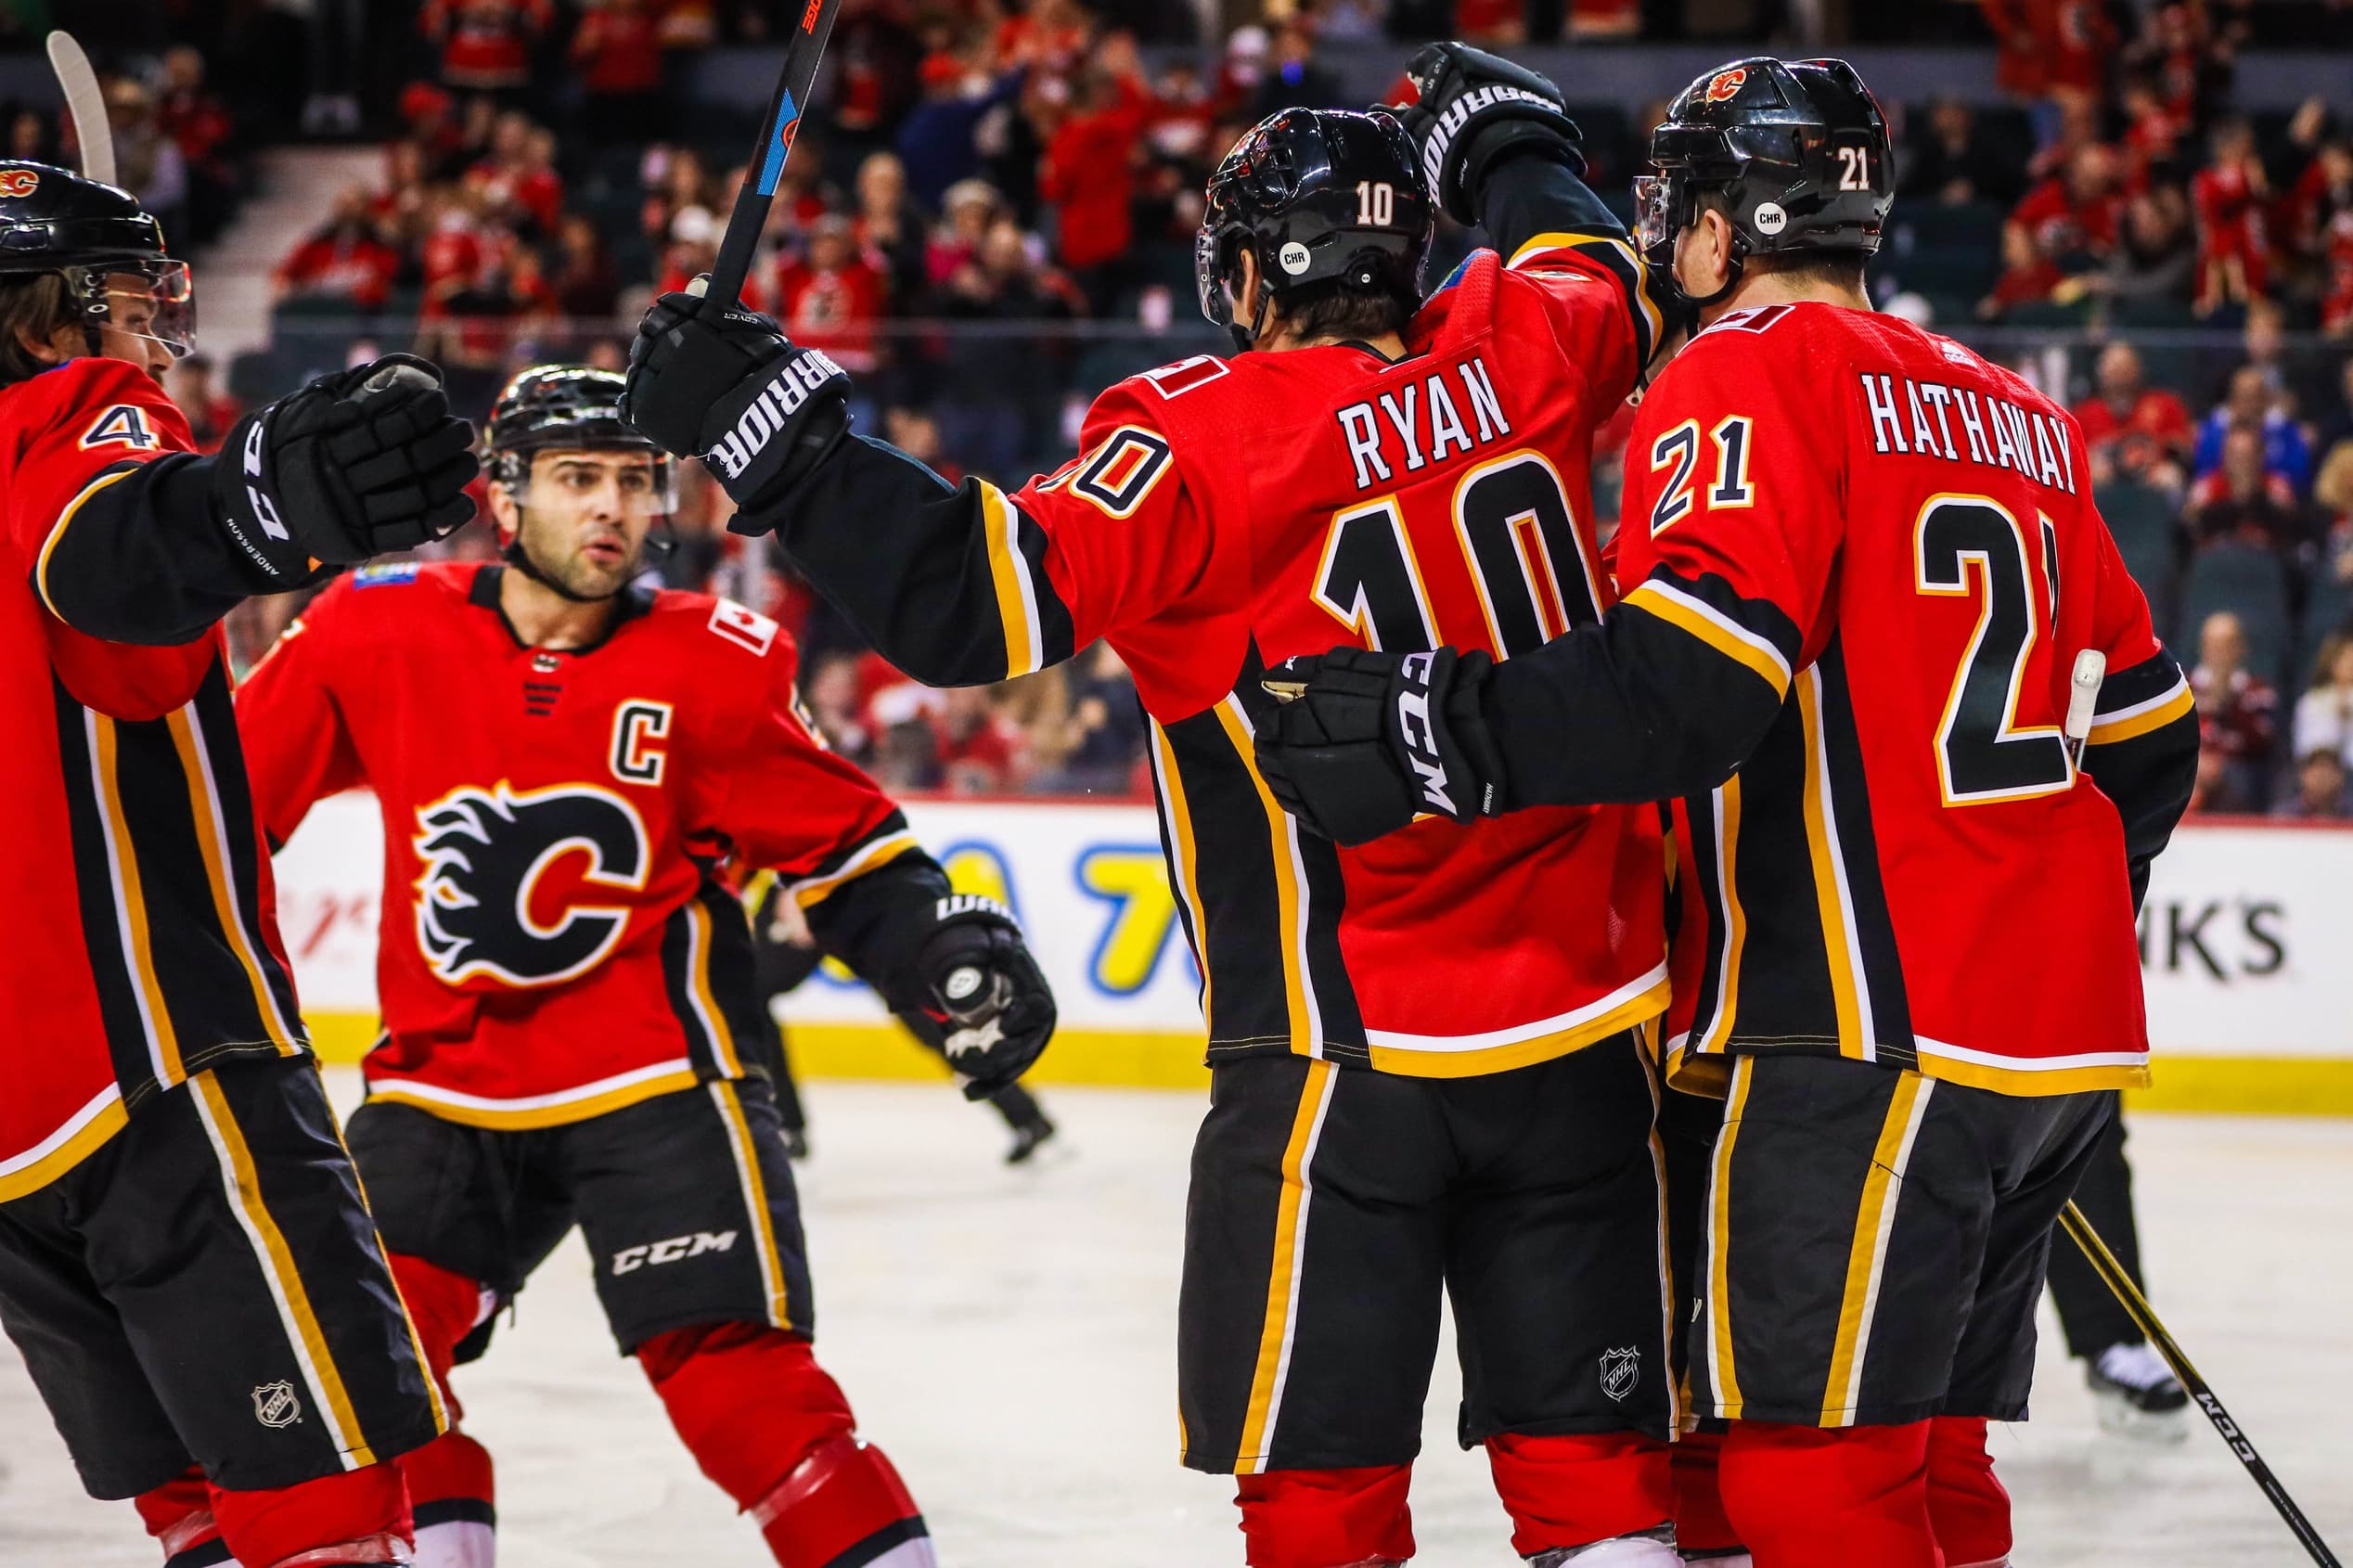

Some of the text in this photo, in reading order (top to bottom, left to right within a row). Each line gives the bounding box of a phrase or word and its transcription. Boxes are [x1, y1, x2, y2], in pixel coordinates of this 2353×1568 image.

[1356, 180, 1394, 225] 10
[1838, 148, 1870, 190] 21
[1758, 212, 1781, 225] CHR
[1284, 251, 1305, 265] CHR
[78, 405, 159, 452] 4
[712, 349, 848, 480] RRIOR
[1337, 356, 1510, 489] RYAN
[1860, 373, 2077, 496] HATHAWAY
[244, 405, 289, 541] CC
[1650, 414, 1756, 540] 21
[226, 518, 280, 575] ANDERSSON
[1311, 448, 1608, 662] 10
[1913, 494, 2078, 807] 2
[609, 699, 673, 787] C
[1398, 650, 1458, 816] CCM
[1074, 841, 1201, 997] 7
[612, 1229, 738, 1276] CCM
[266, 1392, 289, 1420] NHL
[1608, 1360, 1631, 1390] NHL
[2196, 1393, 2257, 1462] CCM
